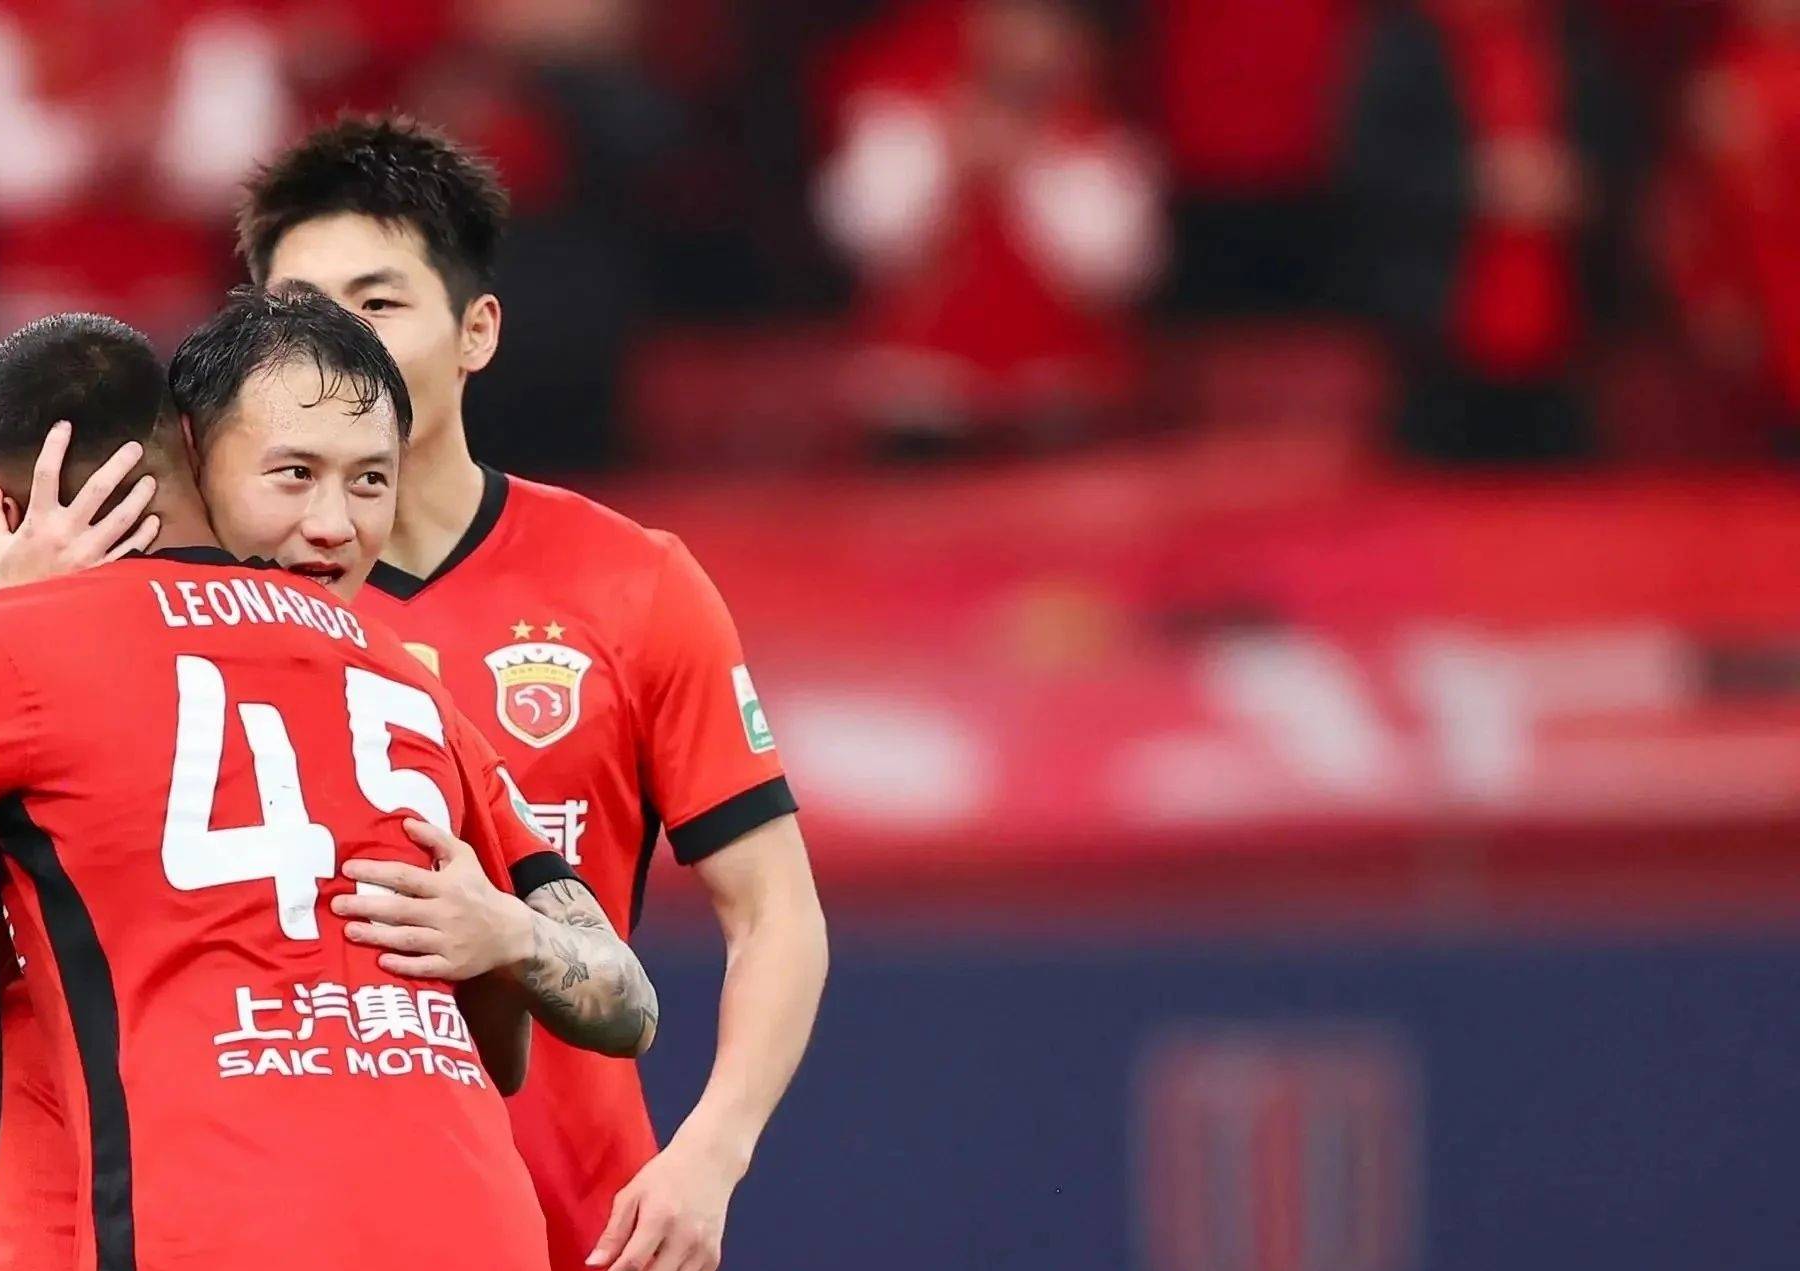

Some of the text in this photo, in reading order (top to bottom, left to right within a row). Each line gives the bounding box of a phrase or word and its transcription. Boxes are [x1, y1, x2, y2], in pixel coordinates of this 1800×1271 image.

[149, 578, 368, 649] LEONARDO
[161, 654, 452, 941] 45
[213, 981, 473, 1054] 上汽集团
[217, 1046, 486, 1090] SAIC MOTOR
